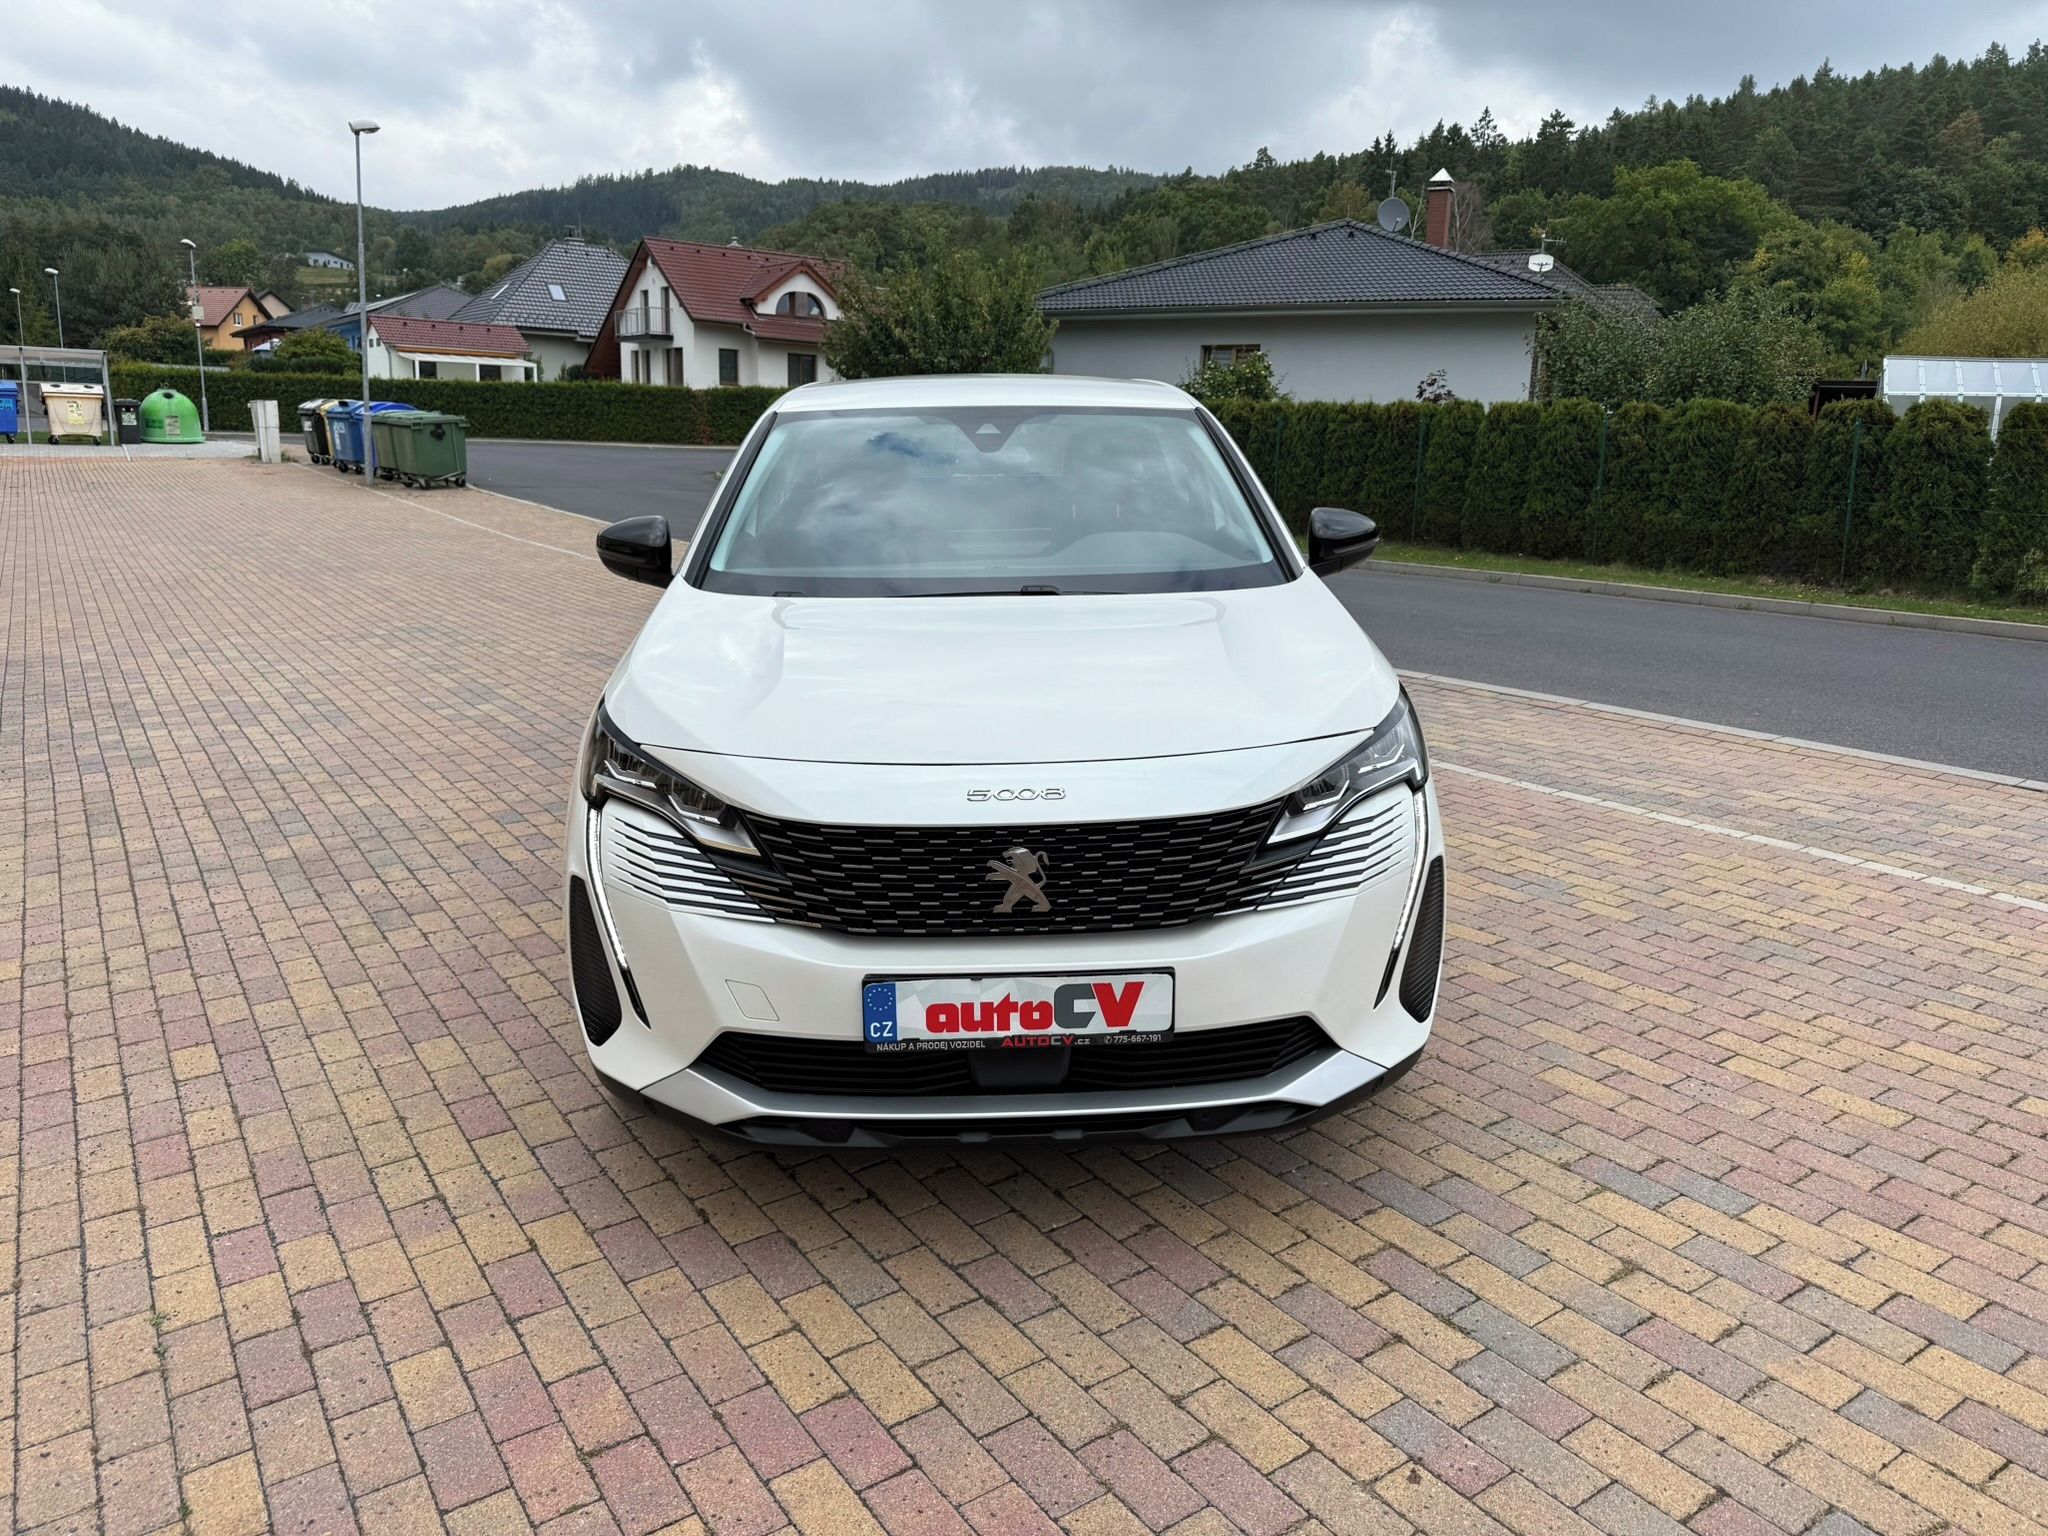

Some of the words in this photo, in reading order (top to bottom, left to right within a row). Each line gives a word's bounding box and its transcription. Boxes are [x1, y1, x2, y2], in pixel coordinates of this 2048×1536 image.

[966, 788, 1066, 802] 5008
[925, 981, 1145, 1033] autoCV
[870, 1021, 893, 1037] CZ
[876, 1041, 906, 1051] NÁKUP
[908, 1042, 915, 1050] A
[916, 1041, 948, 1051] PRODEJ
[950, 1040, 986, 1049] VOZIDEL
[1113, 1034, 1162, 1043] 775-667-191
